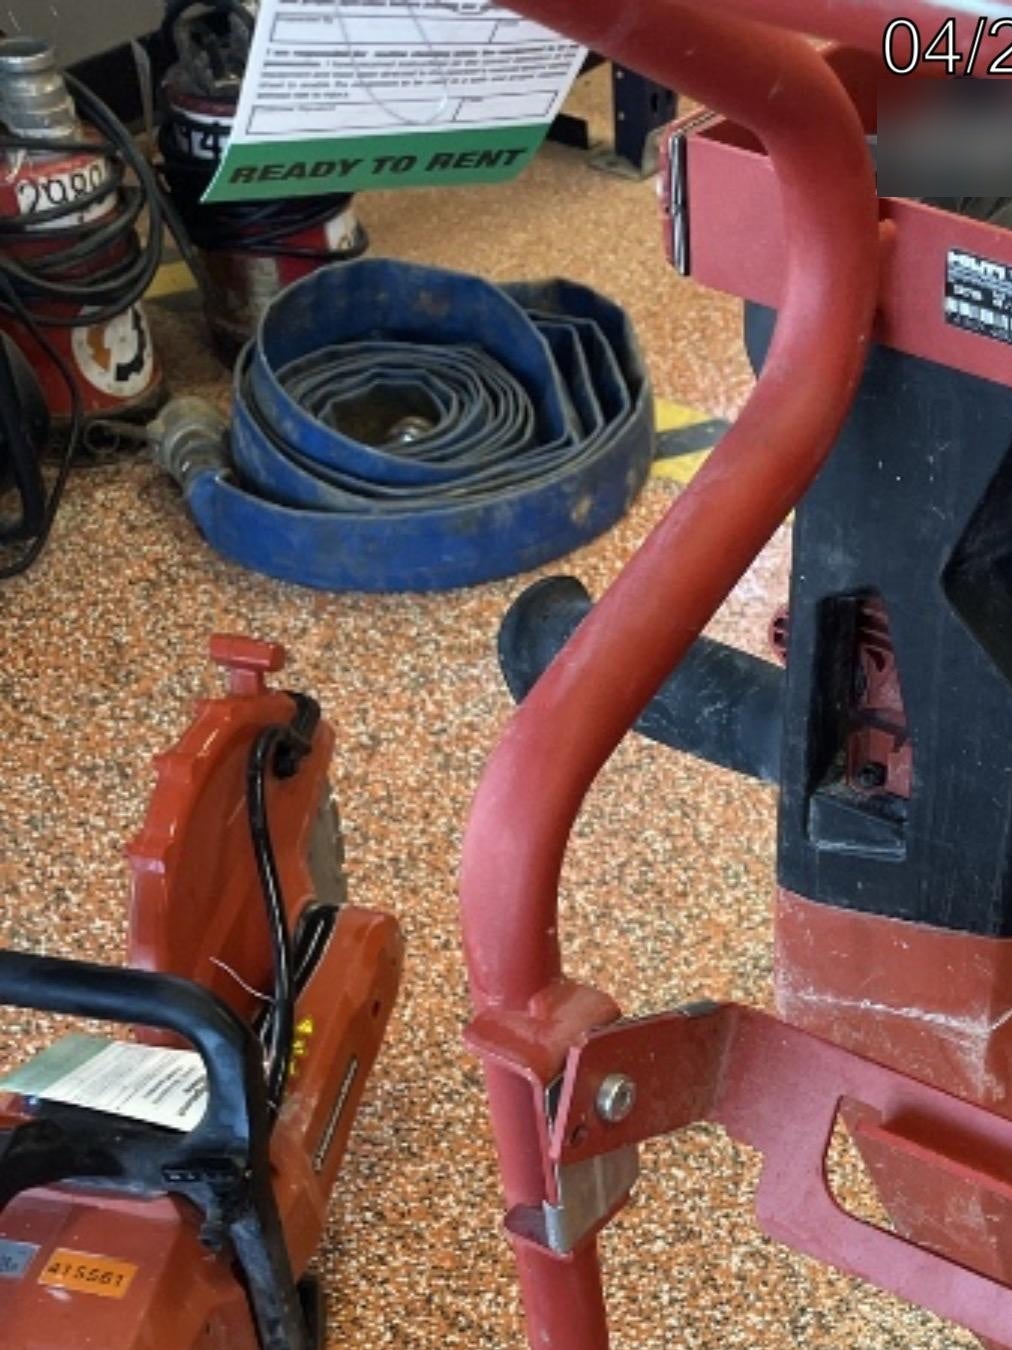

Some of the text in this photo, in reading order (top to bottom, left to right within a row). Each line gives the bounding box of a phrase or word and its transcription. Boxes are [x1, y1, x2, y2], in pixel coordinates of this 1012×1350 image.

[228, 148, 527, 184] READY TO RENT
